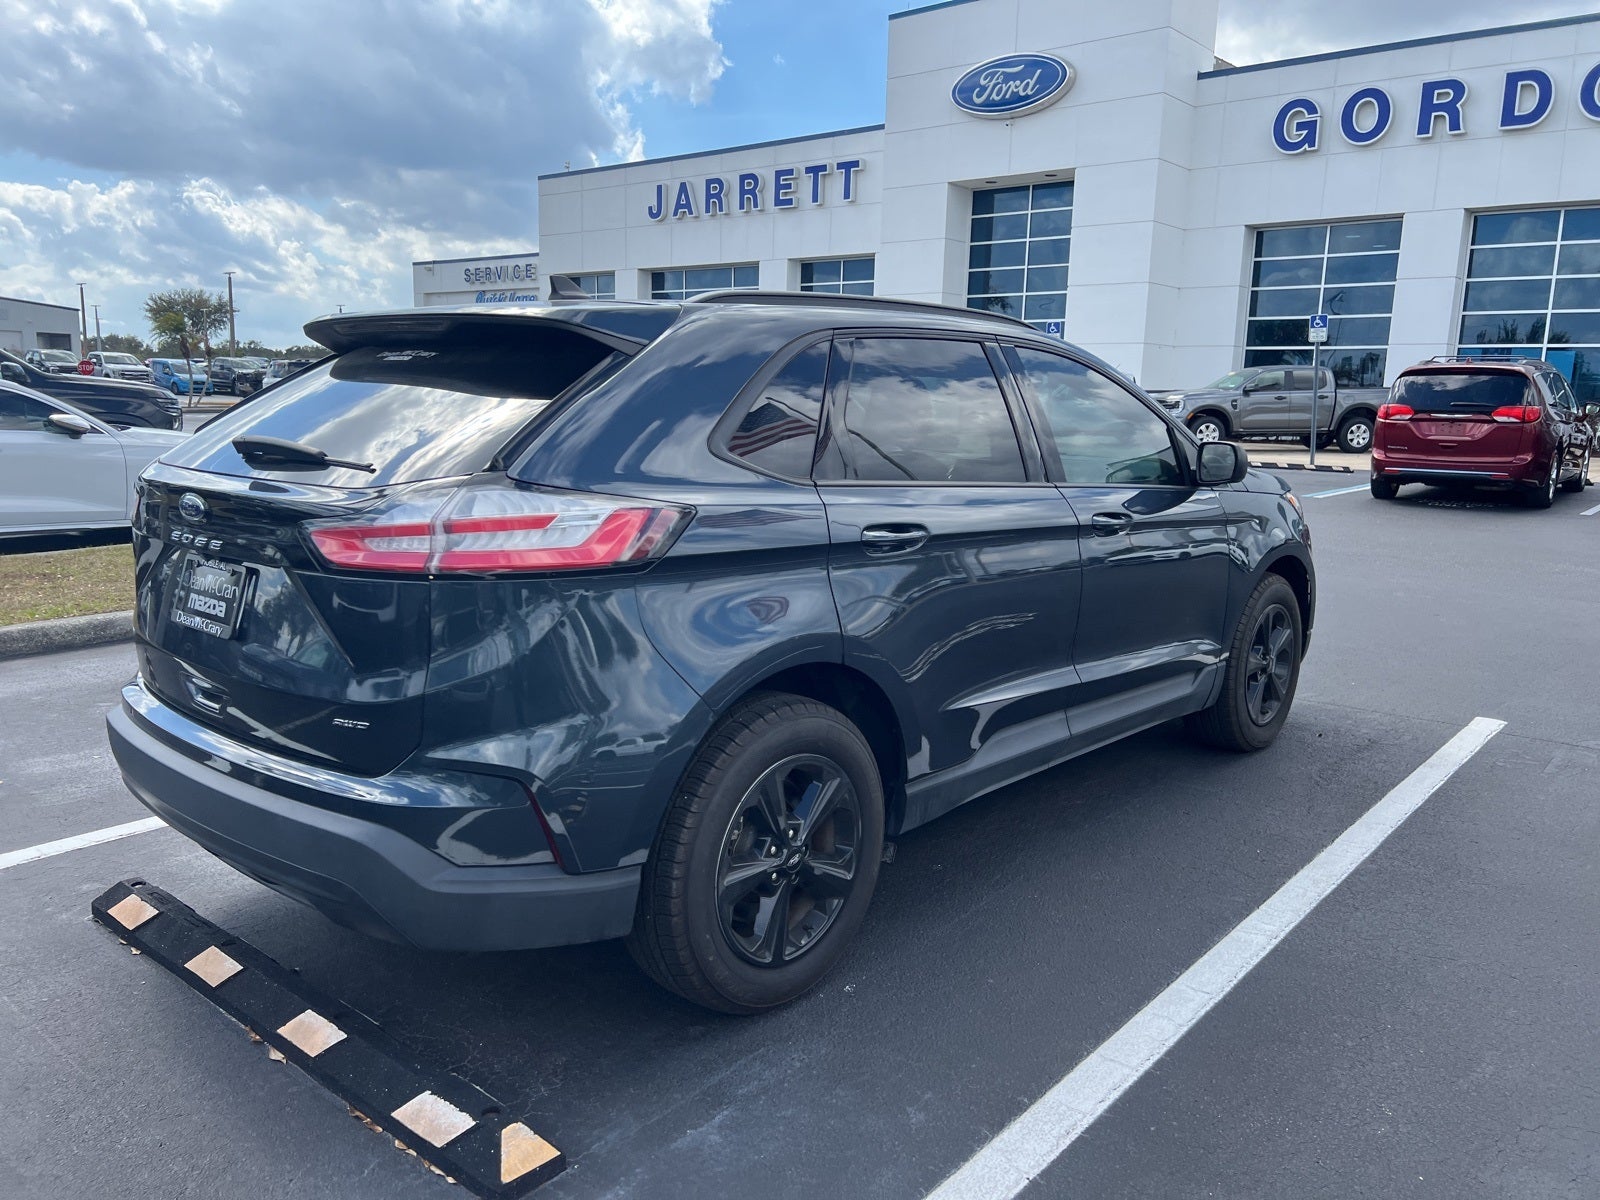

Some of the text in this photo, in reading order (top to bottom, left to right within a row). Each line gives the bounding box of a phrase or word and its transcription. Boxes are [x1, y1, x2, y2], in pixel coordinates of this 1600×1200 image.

[973, 64, 1042, 104] Ford
[648, 158, 865, 221] JARRETT
[464, 264, 535, 283] SERVICE
[171, 530, 223, 550] EDGE
